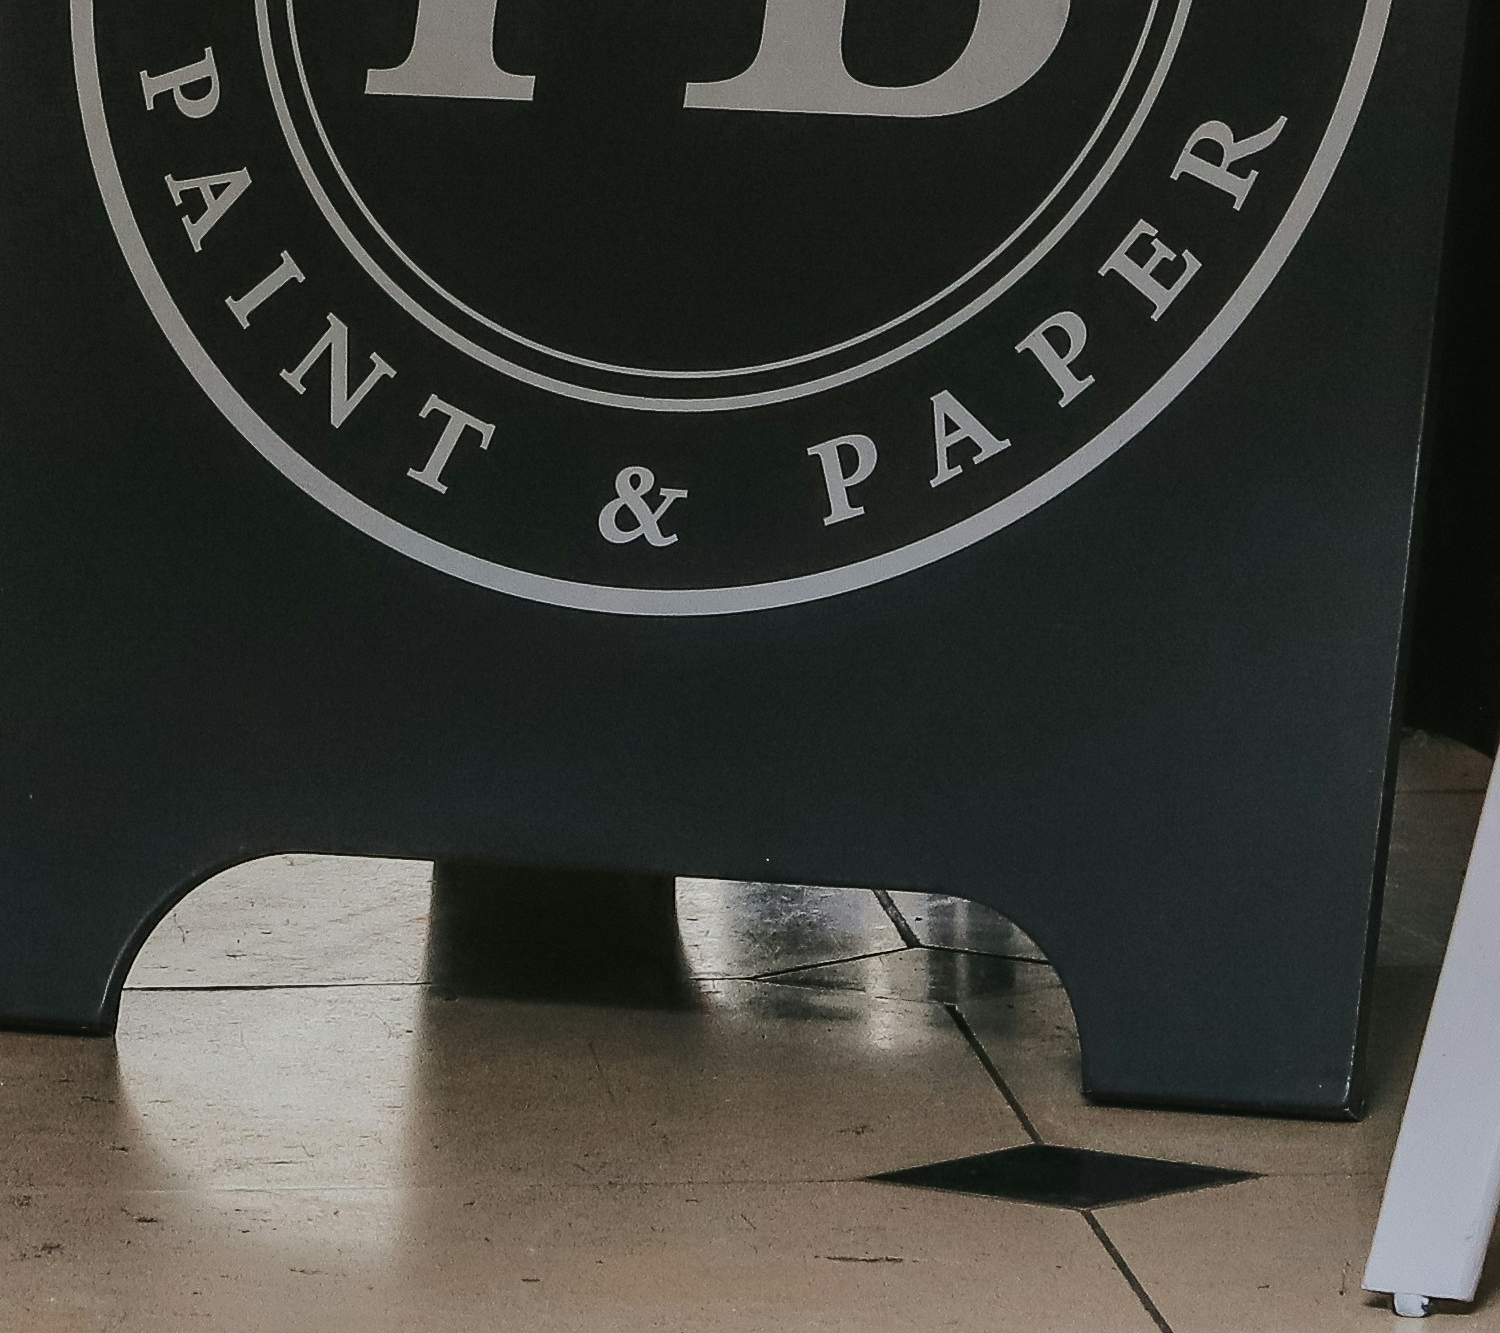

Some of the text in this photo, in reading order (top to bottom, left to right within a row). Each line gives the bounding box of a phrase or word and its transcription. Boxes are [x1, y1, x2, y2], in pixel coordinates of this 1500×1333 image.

[140, 46, 1288, 549] PAINT & PAPER
